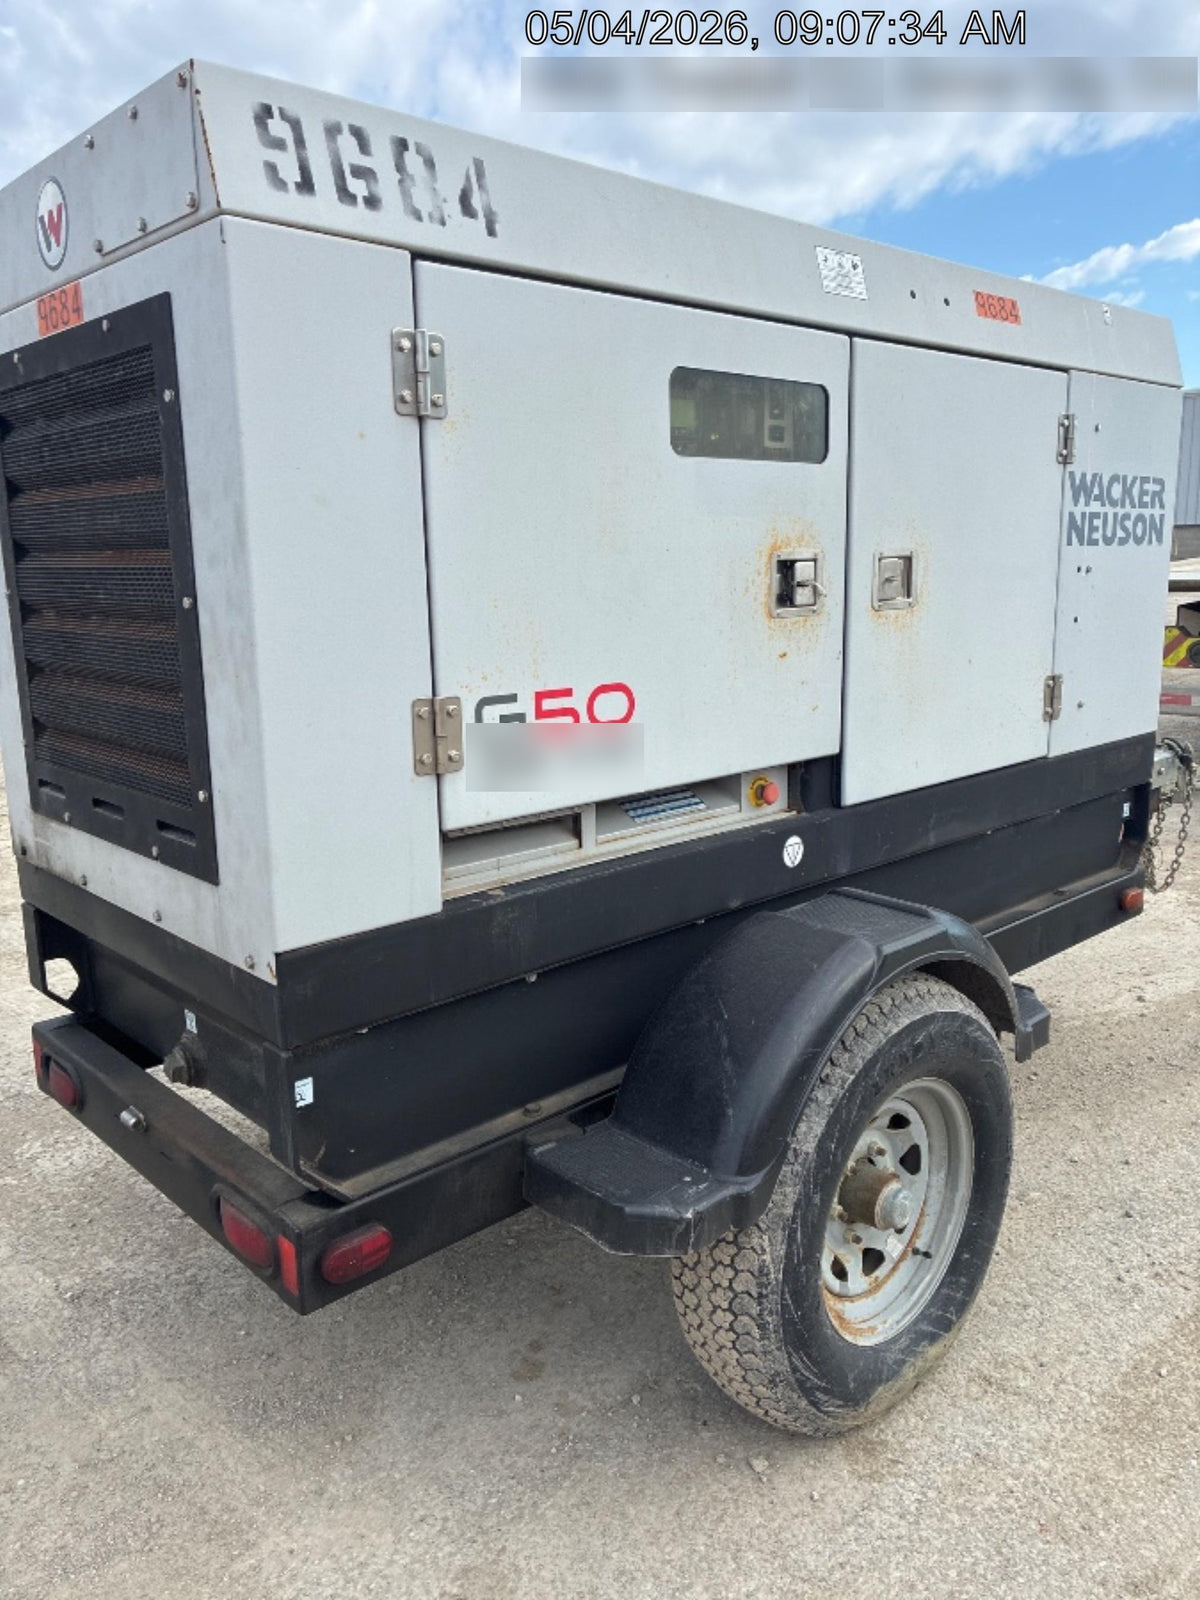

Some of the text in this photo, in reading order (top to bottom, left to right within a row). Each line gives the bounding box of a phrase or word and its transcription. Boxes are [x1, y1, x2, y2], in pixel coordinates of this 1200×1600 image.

[252, 102, 499, 238] 9684
[38, 282, 82, 332] 9684
[975, 290, 1020, 324] 9684
[1069, 471, 1166, 510] WACKER
[1067, 512, 1165, 547] NEUSON
[475, 682, 635, 724] G50
